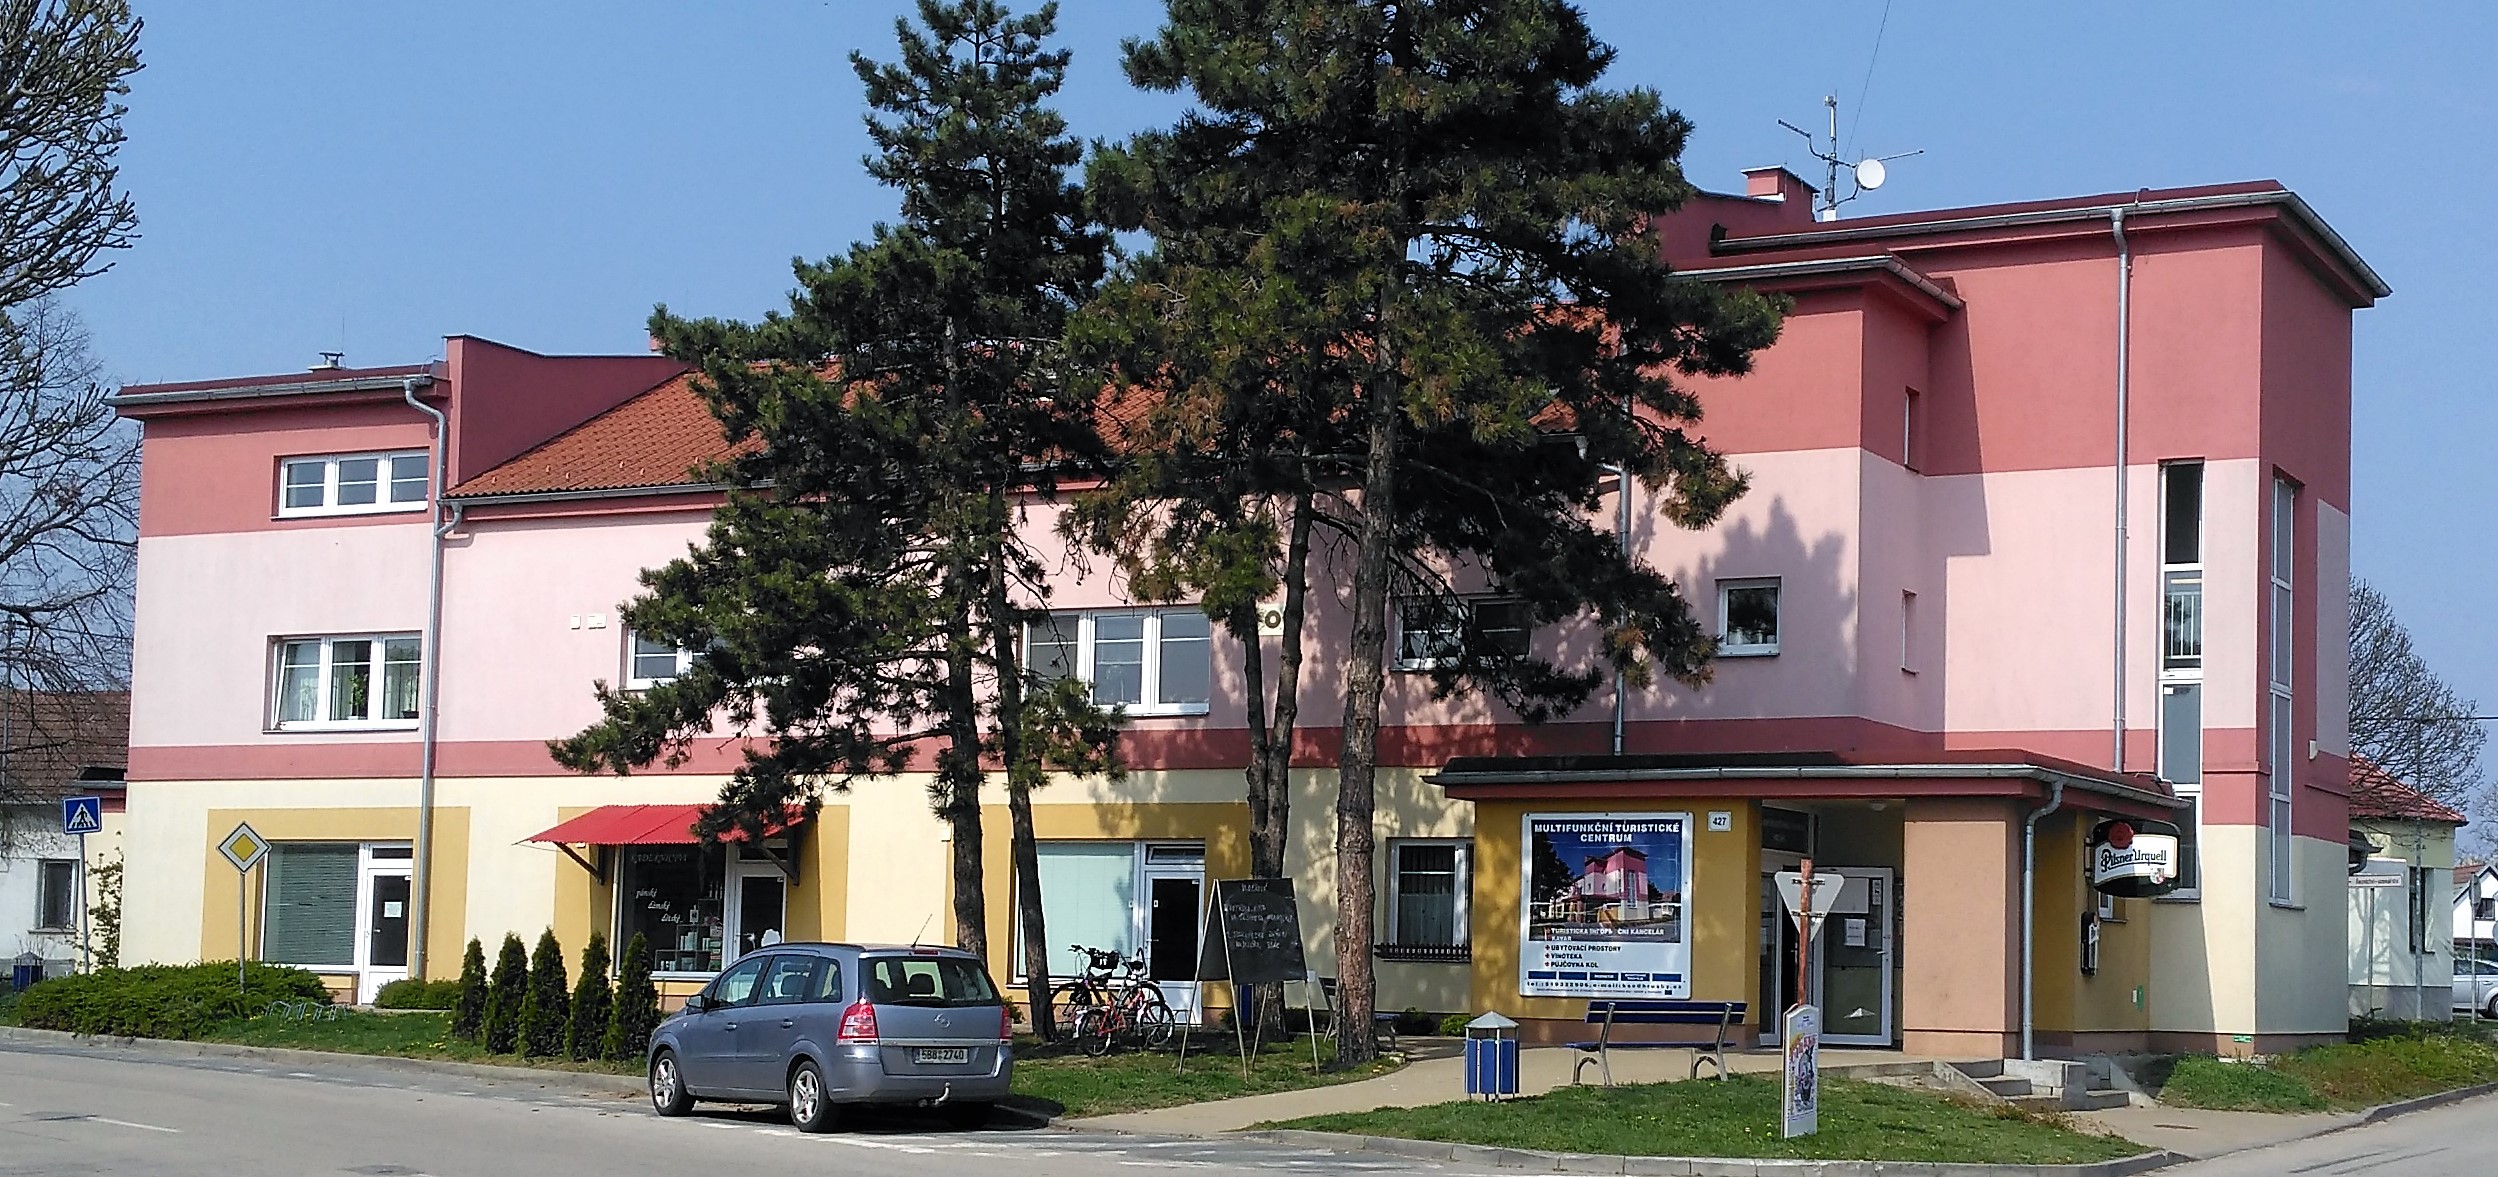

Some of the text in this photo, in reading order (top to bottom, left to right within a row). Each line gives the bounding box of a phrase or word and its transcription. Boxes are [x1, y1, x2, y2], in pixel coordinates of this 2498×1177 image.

[1712, 816, 1727, 826] 427
[1534, 822, 1680, 832] MULTIFUNKČNÍ TURISTICKÉ
[1580, 833, 1633, 843] CENTRUM
[2101, 848, 2167, 873] Pilsner Urquell
[943, 1049, 964, 1060] 2740
